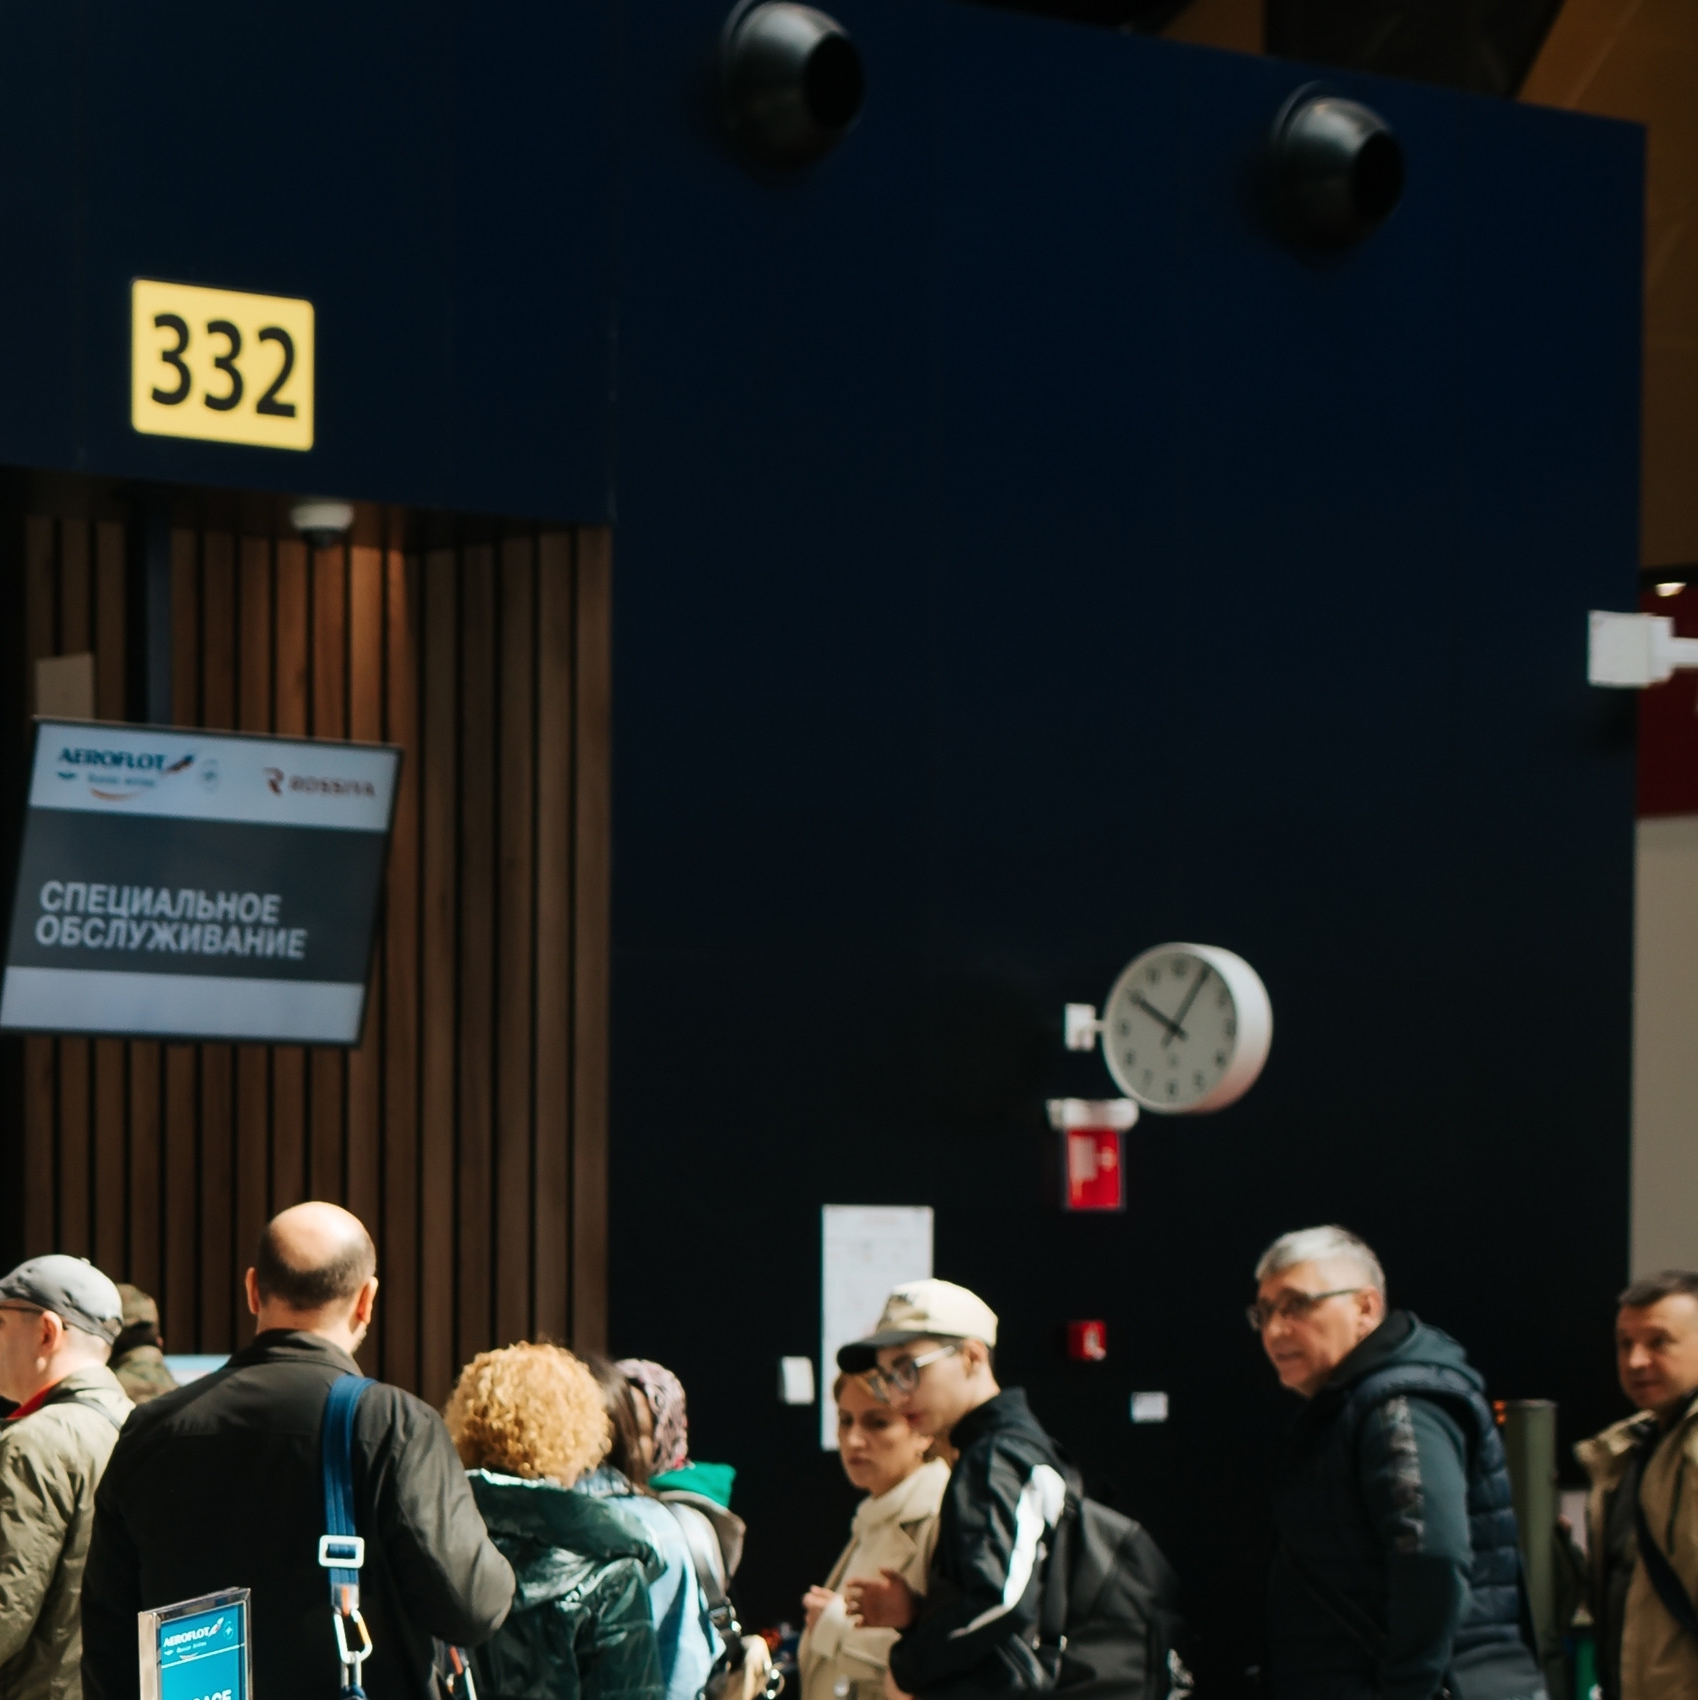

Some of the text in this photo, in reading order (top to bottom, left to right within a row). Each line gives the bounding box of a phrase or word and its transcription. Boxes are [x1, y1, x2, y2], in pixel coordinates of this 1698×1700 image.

[151, 314, 297, 419] 332
[58, 747, 166, 772] AEROFLOT
[39, 880, 282, 925] СПЕЦИАЛЬНОЕ
[34, 914, 308, 960] ОБСЛУЖИВАНИЕ
[162, 1625, 211, 1648] AEROFLOT
